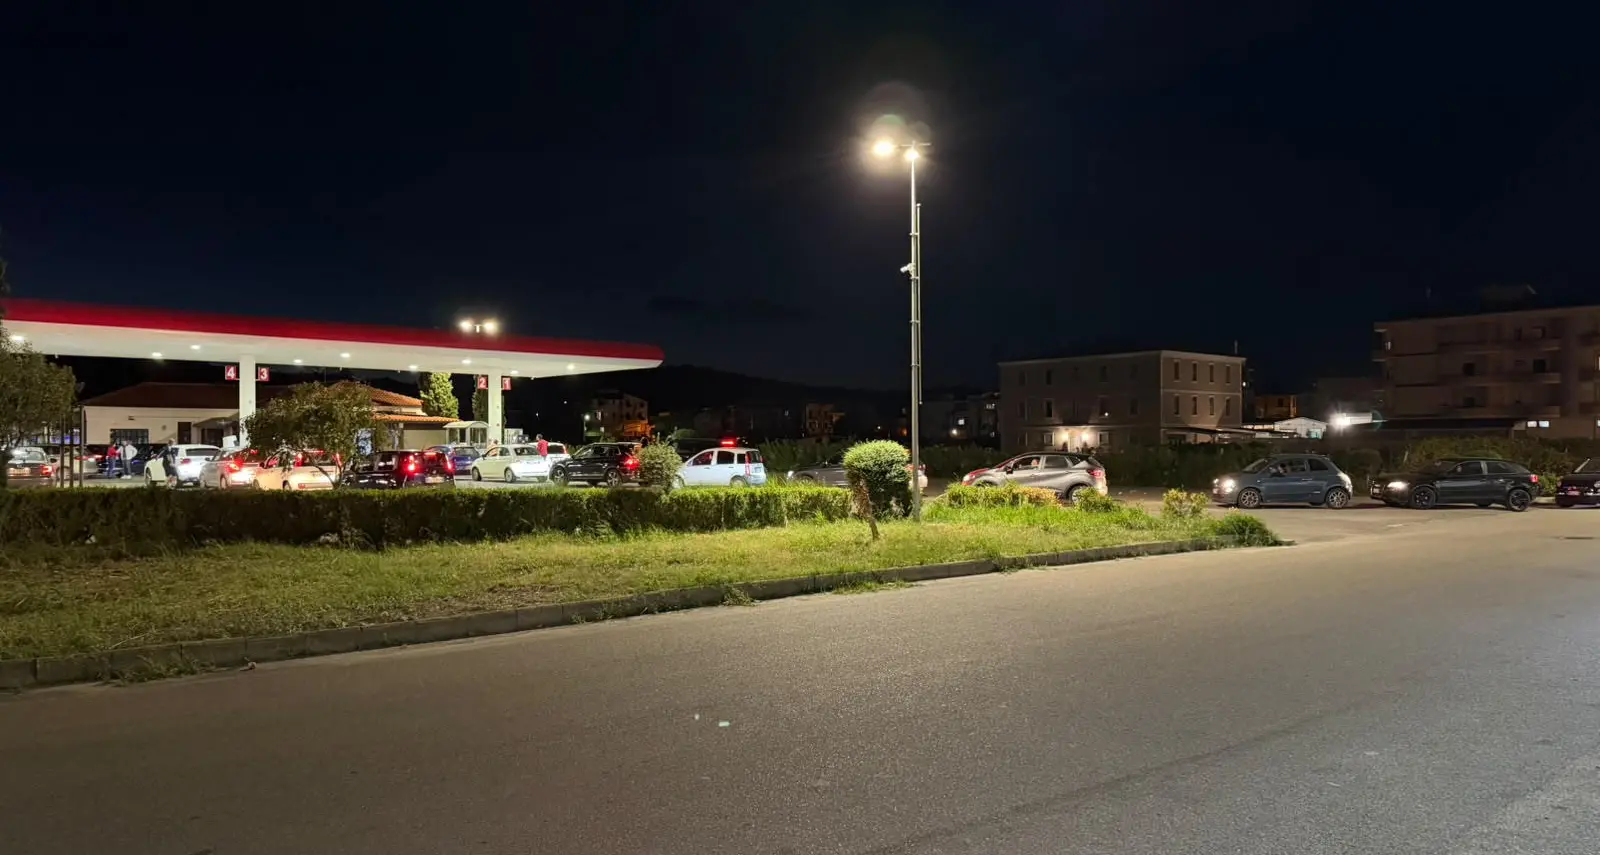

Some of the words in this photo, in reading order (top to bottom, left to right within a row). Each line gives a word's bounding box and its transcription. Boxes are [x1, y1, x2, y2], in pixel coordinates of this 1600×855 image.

[227, 366, 235, 379] 4
[260, 367, 268, 380] 3
[479, 377, 486, 389] 2
